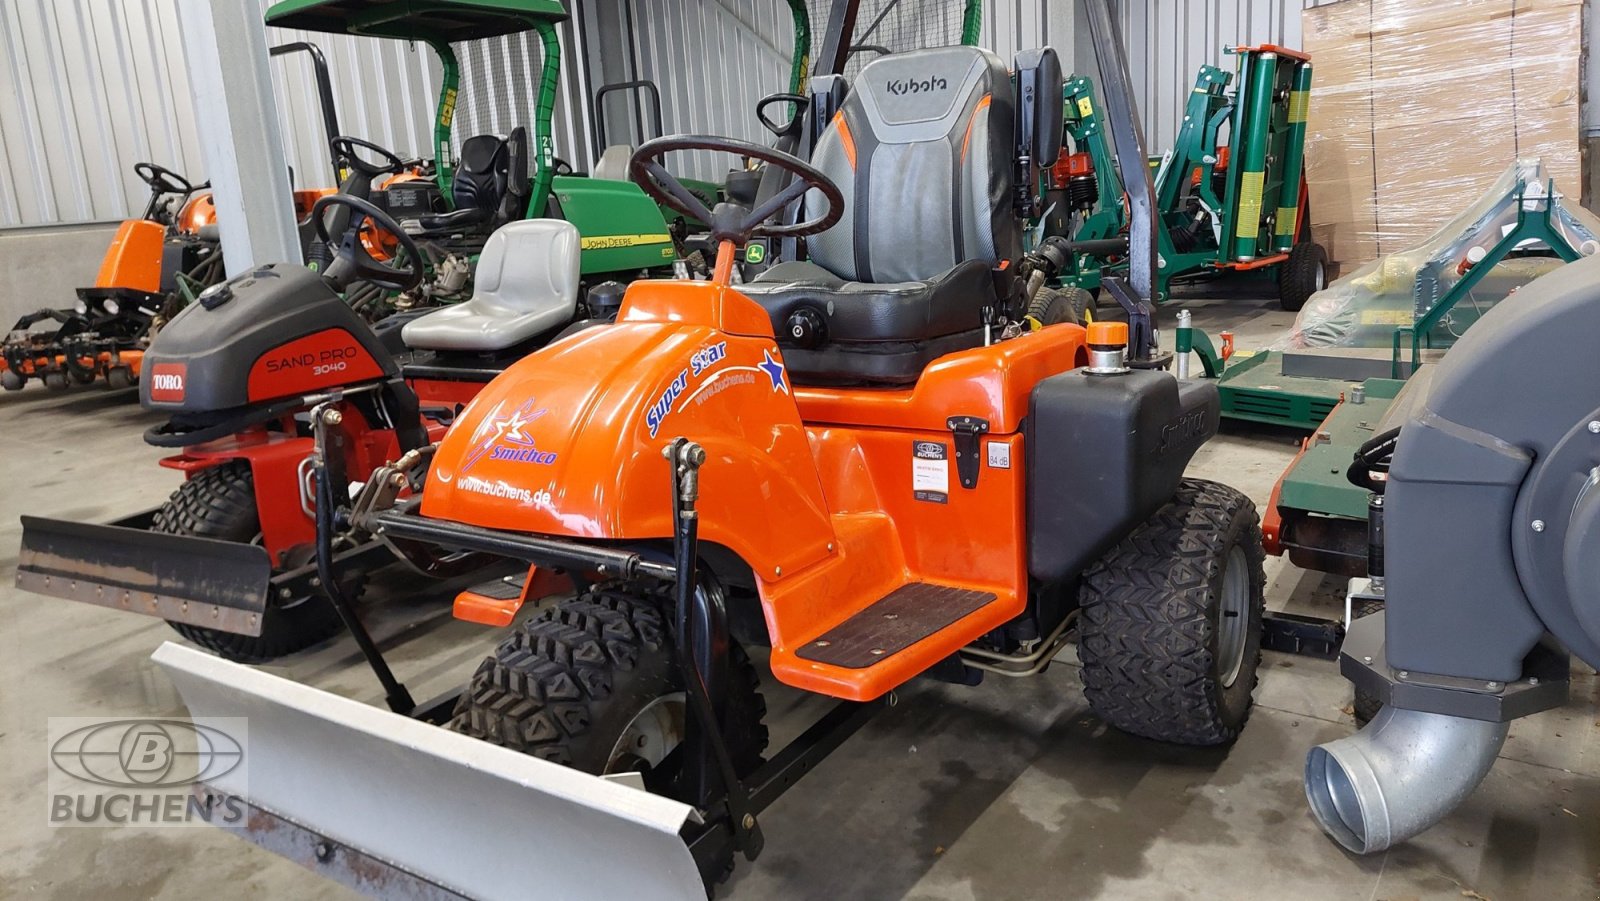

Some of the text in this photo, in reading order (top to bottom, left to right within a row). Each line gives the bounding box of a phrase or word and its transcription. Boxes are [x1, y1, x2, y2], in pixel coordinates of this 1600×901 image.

[887, 75, 947, 95] Kubota
[587, 237, 633, 249] JOHN DEERE
[266, 346, 357, 373] SAND PRO
[312, 361, 347, 376] 3040
[153, 374, 183, 390] TORO
[646, 341, 727, 439] Super Star
[694, 371, 756, 406] www.buchens.de
[490, 445, 558, 465] Smithco
[457, 476, 551, 504] www.buchens.de
